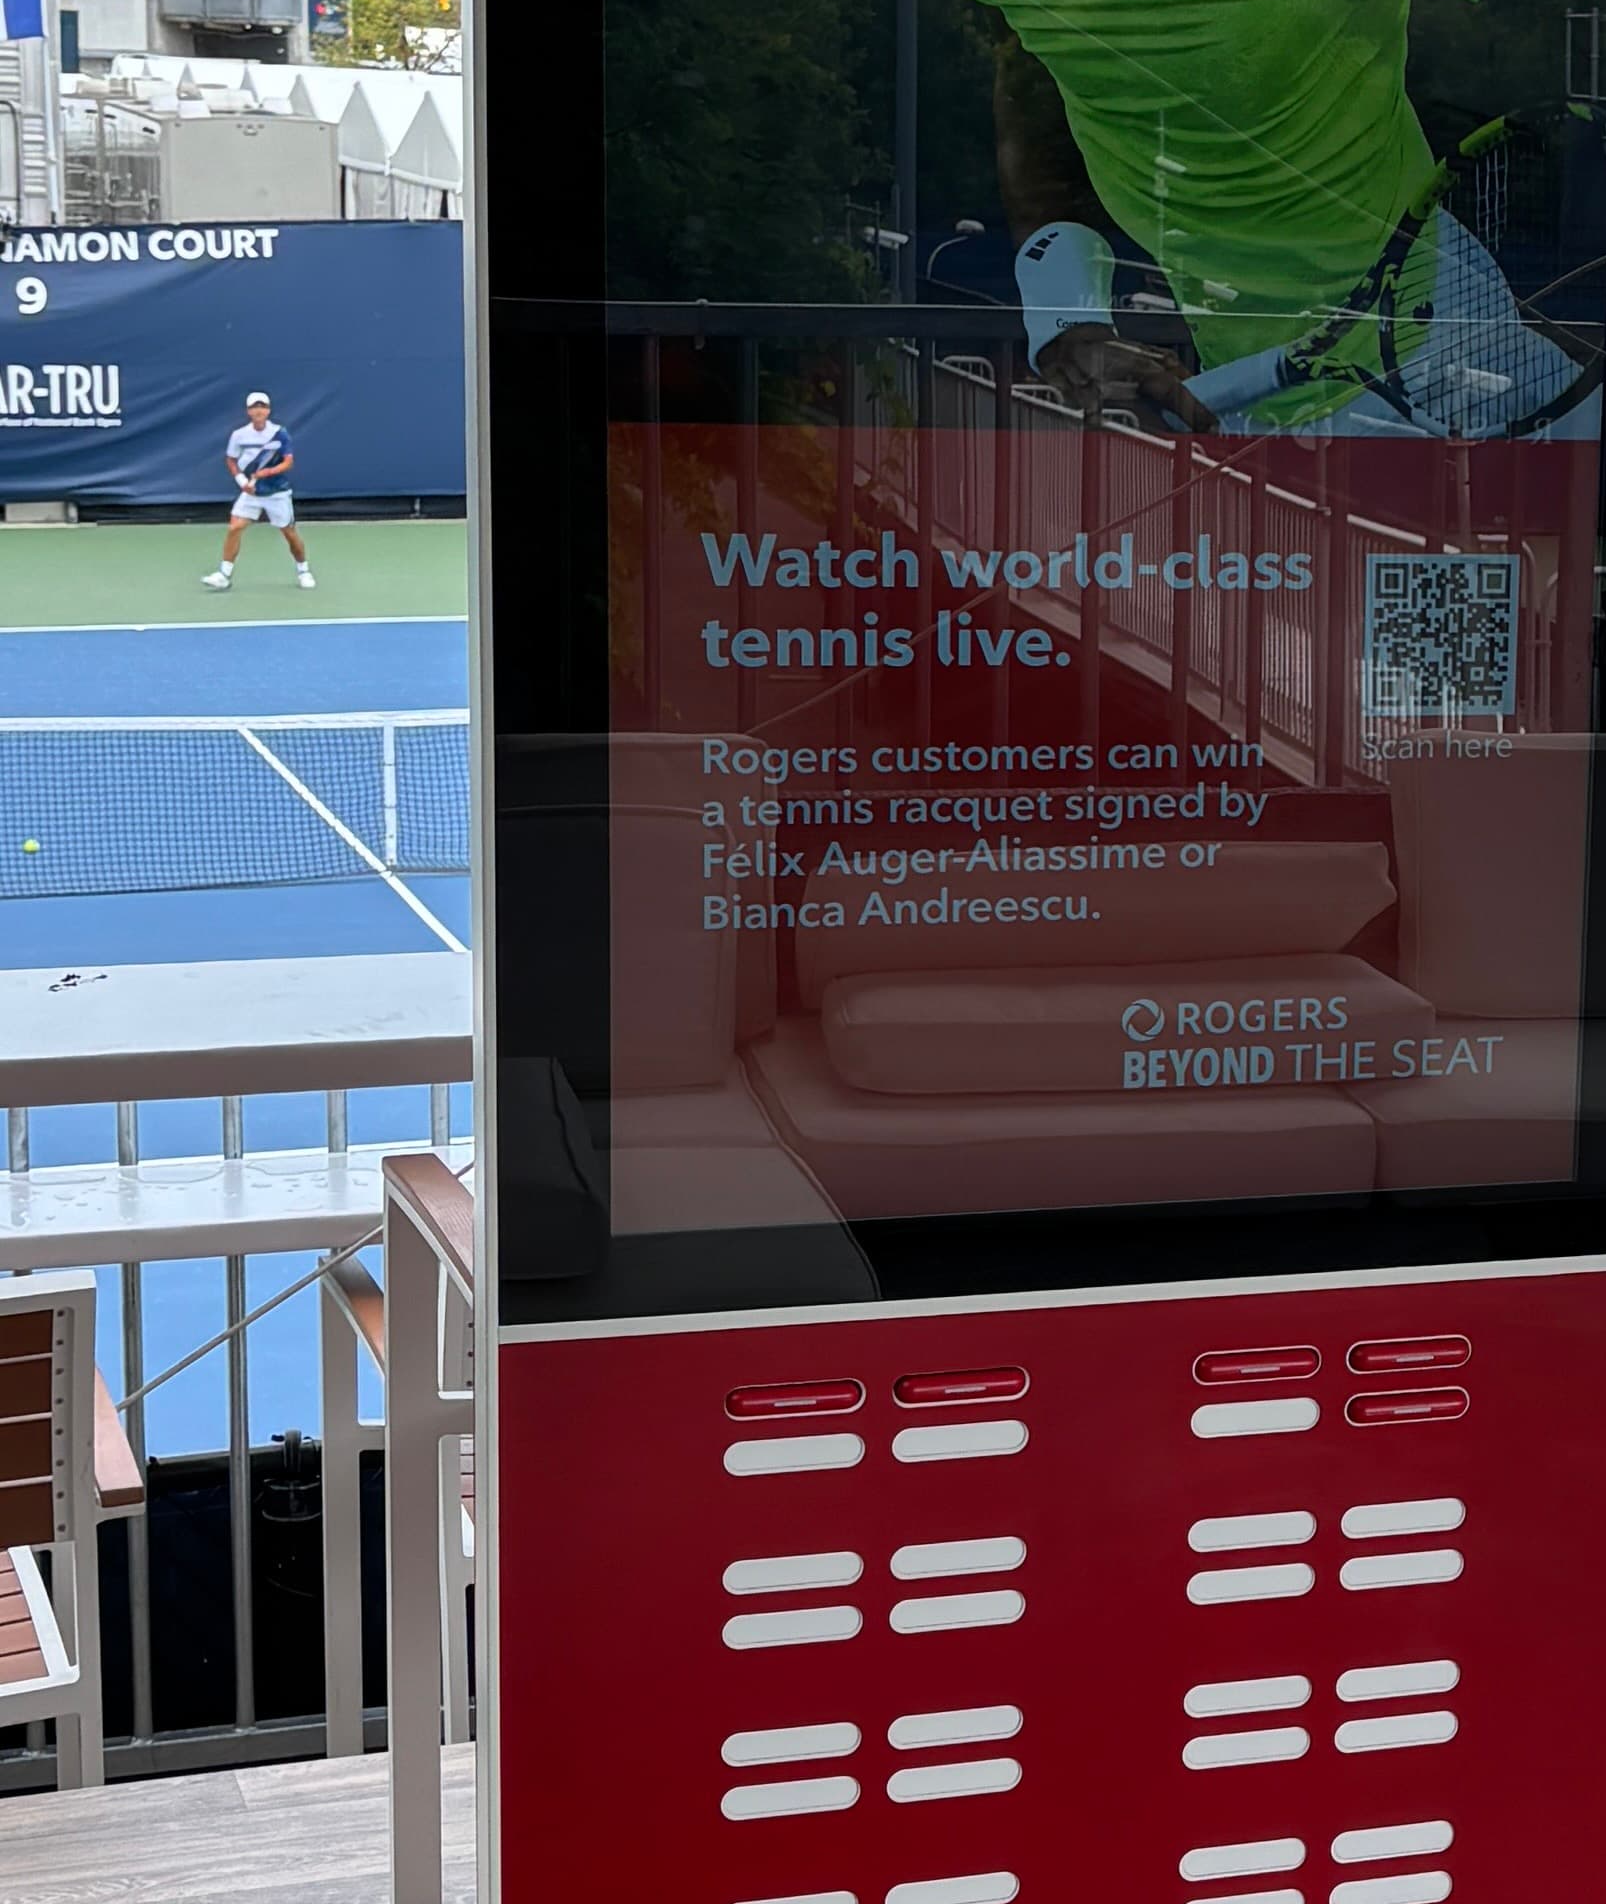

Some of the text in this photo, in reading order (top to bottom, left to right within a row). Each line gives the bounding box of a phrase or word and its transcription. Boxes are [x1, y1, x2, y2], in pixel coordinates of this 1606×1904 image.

[148, 229, 279, 261] COURT
[15, 276, 48, 315] 9
[700, 531, 1314, 591] Watch world-class
[701, 611, 1071, 668] tennis live.
[703, 733, 1264, 784] Rogers customers can win
[1363, 729, 1513, 760] Scan here
[702, 782, 1268, 832] a tennis racquet signed by
[703, 835, 1222, 884] Félix Auger-Aliassime or
[703, 888, 1101, 930] Bianca Andreescu.
[1177, 996, 1348, 1036] ROGERS
[1123, 1036, 1504, 1089] BEYOND THE SEAT
